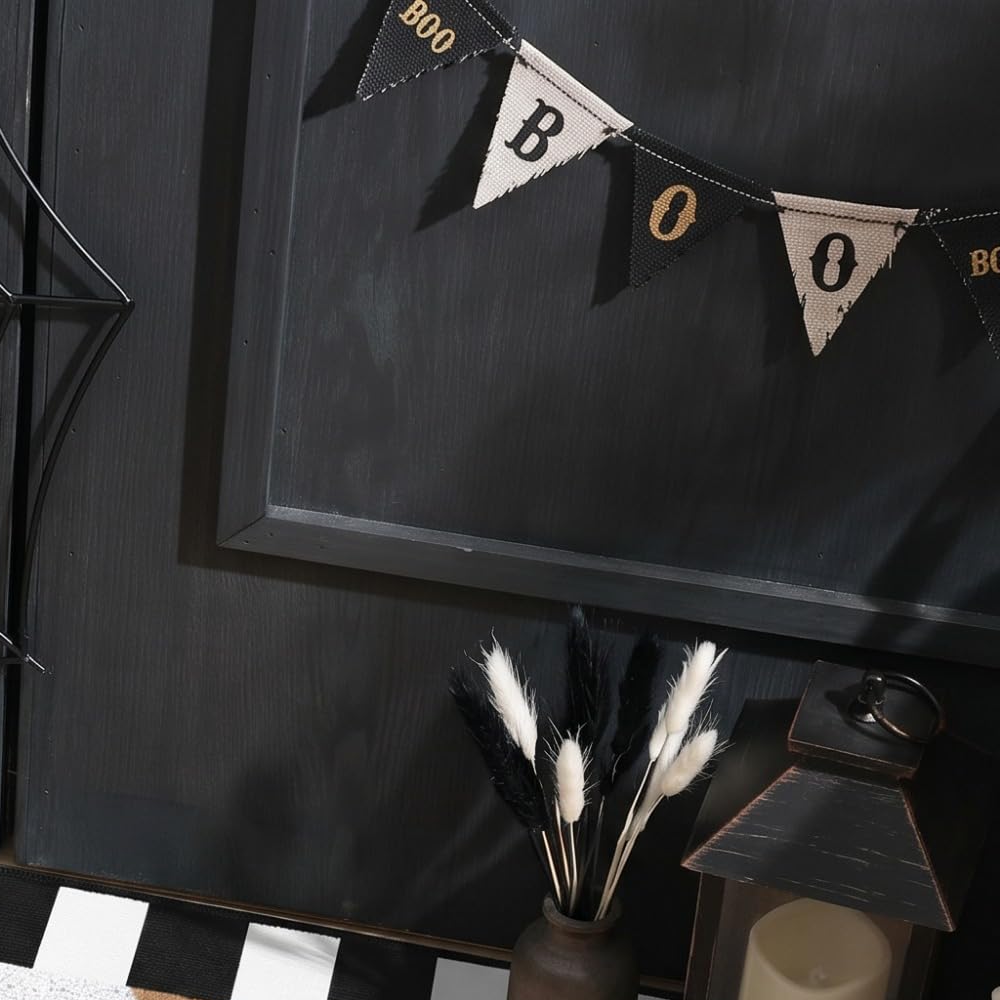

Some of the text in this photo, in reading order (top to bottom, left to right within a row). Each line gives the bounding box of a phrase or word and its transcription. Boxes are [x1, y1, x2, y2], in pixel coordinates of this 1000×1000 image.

[398, 0, 456, 54] BOO
[504, 98, 858, 291] B O O
